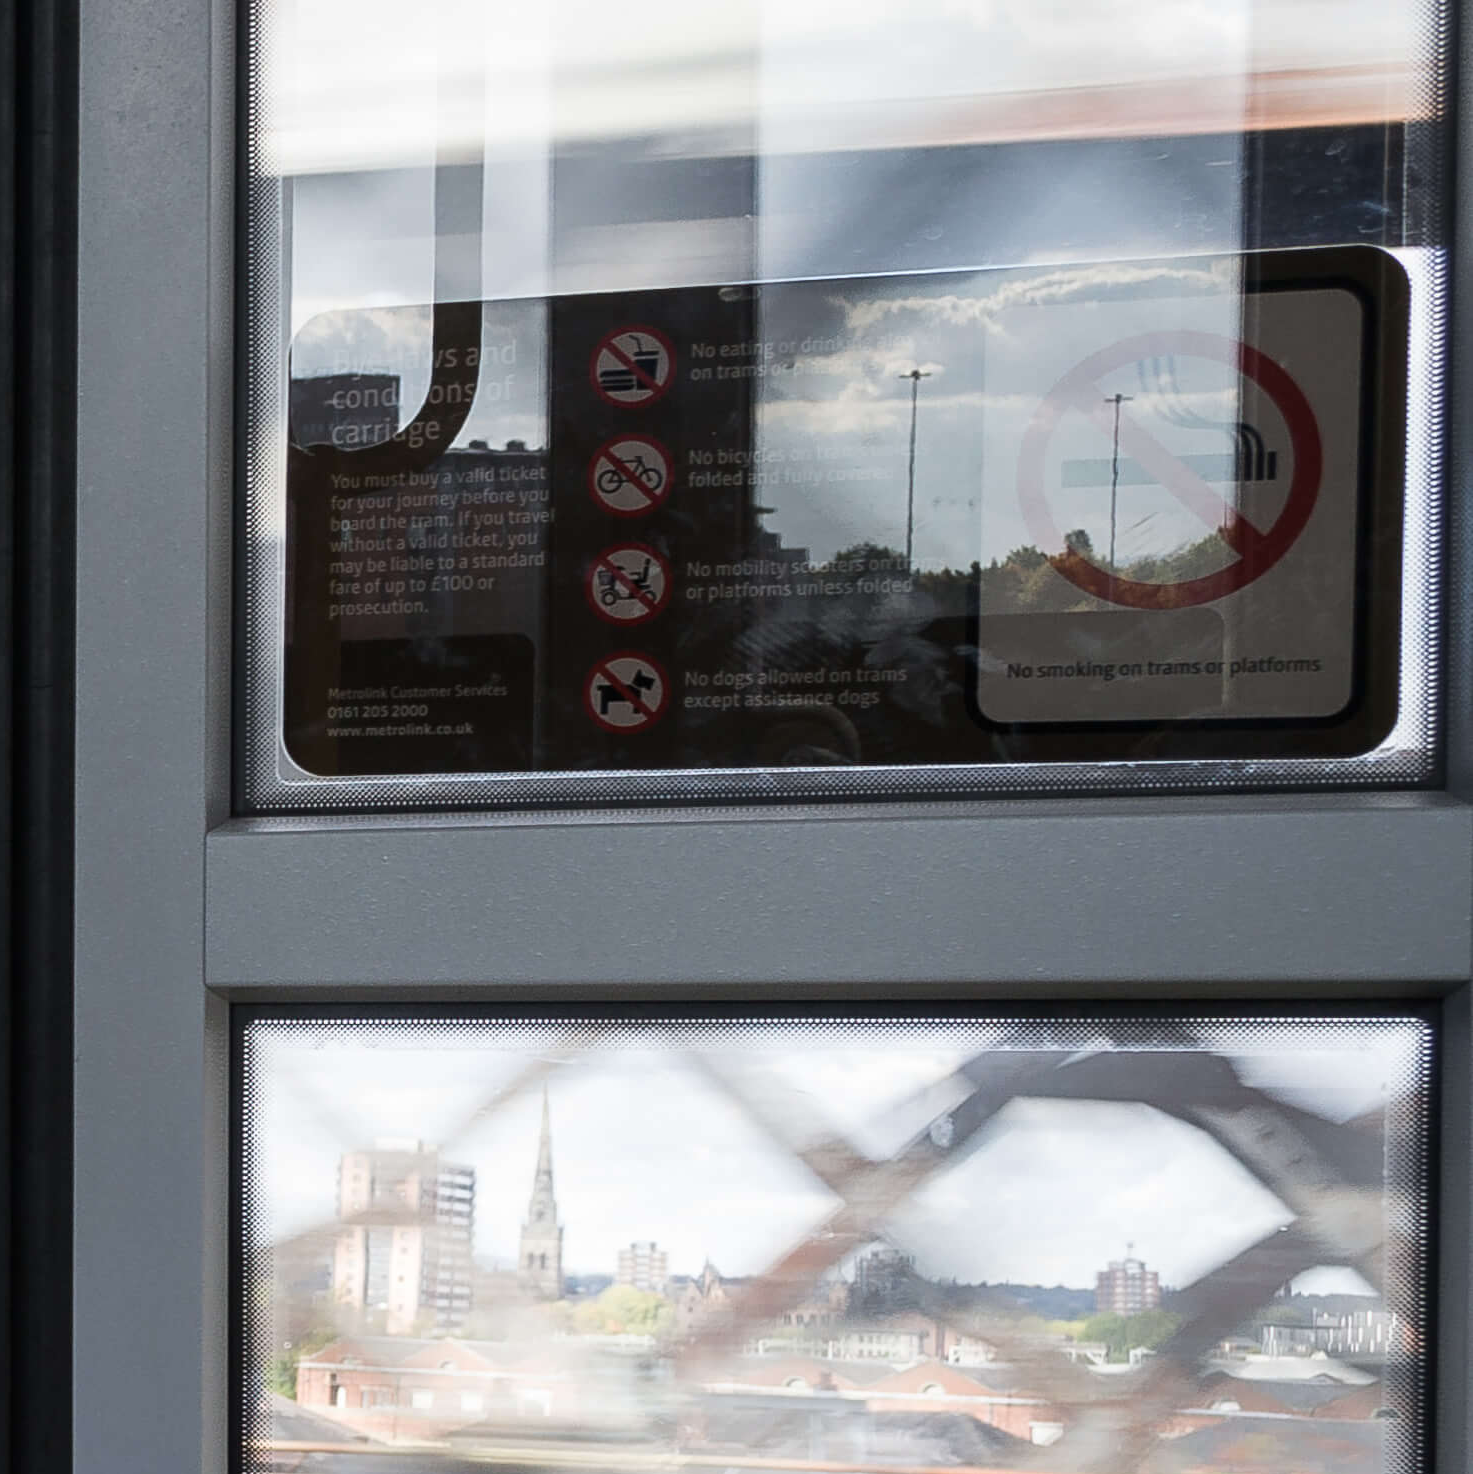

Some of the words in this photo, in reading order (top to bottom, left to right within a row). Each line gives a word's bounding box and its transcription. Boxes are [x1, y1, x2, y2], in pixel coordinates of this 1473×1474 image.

[466, 339, 517, 366] and
[690, 343, 716, 359] No
[719, 339, 774, 360] eating
[690, 366, 713, 381] on
[716, 363, 765, 380] trams
[485, 374, 516, 400] of
[331, 417, 441, 449] carriage
[688, 449, 714, 465] No
[330, 474, 360, 489] You
[364, 472, 405, 487] must
[409, 470, 438, 489] buy
[442, 472, 453, 484] a
[457, 468, 495, 483] valid
[499, 466, 547, 481] ticket
[687, 469, 743, 488] folded
[748, 467, 779, 486] and
[330, 495, 352, 511] for
[356, 496, 393, 514] your
[394, 491, 459, 512] journey
[462, 488, 514, 505] before
[518, 489, 550, 506] you
[330, 515, 376, 532] board
[379, 514, 407, 530] the
[411, 513, 454, 529] tram.
[458, 510, 471, 526] If
[473, 513, 504, 530] you
[508, 508, 556, 524] travel
[330, 535, 392, 552] without
[396, 539, 406, 550] a
[409, 533, 447, 549] valid
[453, 531, 502, 549] ticket,
[507, 532, 538, 548] you
[329, 561, 363, 576] may
[367, 558, 387, 573] be
[390, 556, 435, 572] liable
[438, 556, 454, 570] to
[459, 557, 469, 569] a
[472, 551, 545, 568] standard
[687, 561, 711, 577] No
[715, 558, 786, 580] mobility
[790, 555, 865, 575] scooters
[869, 557, 892, 572] on
[329, 580, 361, 595] fare
[364, 578, 381, 593] of
[385, 580, 406, 596] up
[409, 577, 427, 592] to
[431, 575, 474, 592] £100
[477, 577, 495, 590] or
[686, 584, 704, 600] or
[708, 581, 791, 602] platforms
[796, 578, 853, 597] unless
[856, 576, 914, 595] folded
[329, 600, 430, 619] prosecution.
[684, 671, 709, 688] No
[712, 669, 754, 691] dogs
[757, 667, 825, 688] allowed
[829, 669, 852, 685] on
[855, 667, 908, 683] trams
[1006, 662, 1034, 679] No
[1036, 660, 1116, 681] smoking
[1118, 661, 1142, 677] on
[1146, 659, 1202, 677] trams
[1204, 660, 1226, 675] or
[1229, 656, 1322, 679] platforms
[328, 686, 388, 700] Metrolink
[390, 685, 452, 699] Customer
[454, 683, 508, 697] Services
[684, 693, 740, 712] except
[743, 690, 833, 709] assistance
[837, 688, 880, 709] dogs
[327, 706, 359, 719] 0161
[363, 705, 389, 718] 205
[392, 704, 428, 718] 2000
[326, 722, 474, 738] www.metrolink.co.uk
